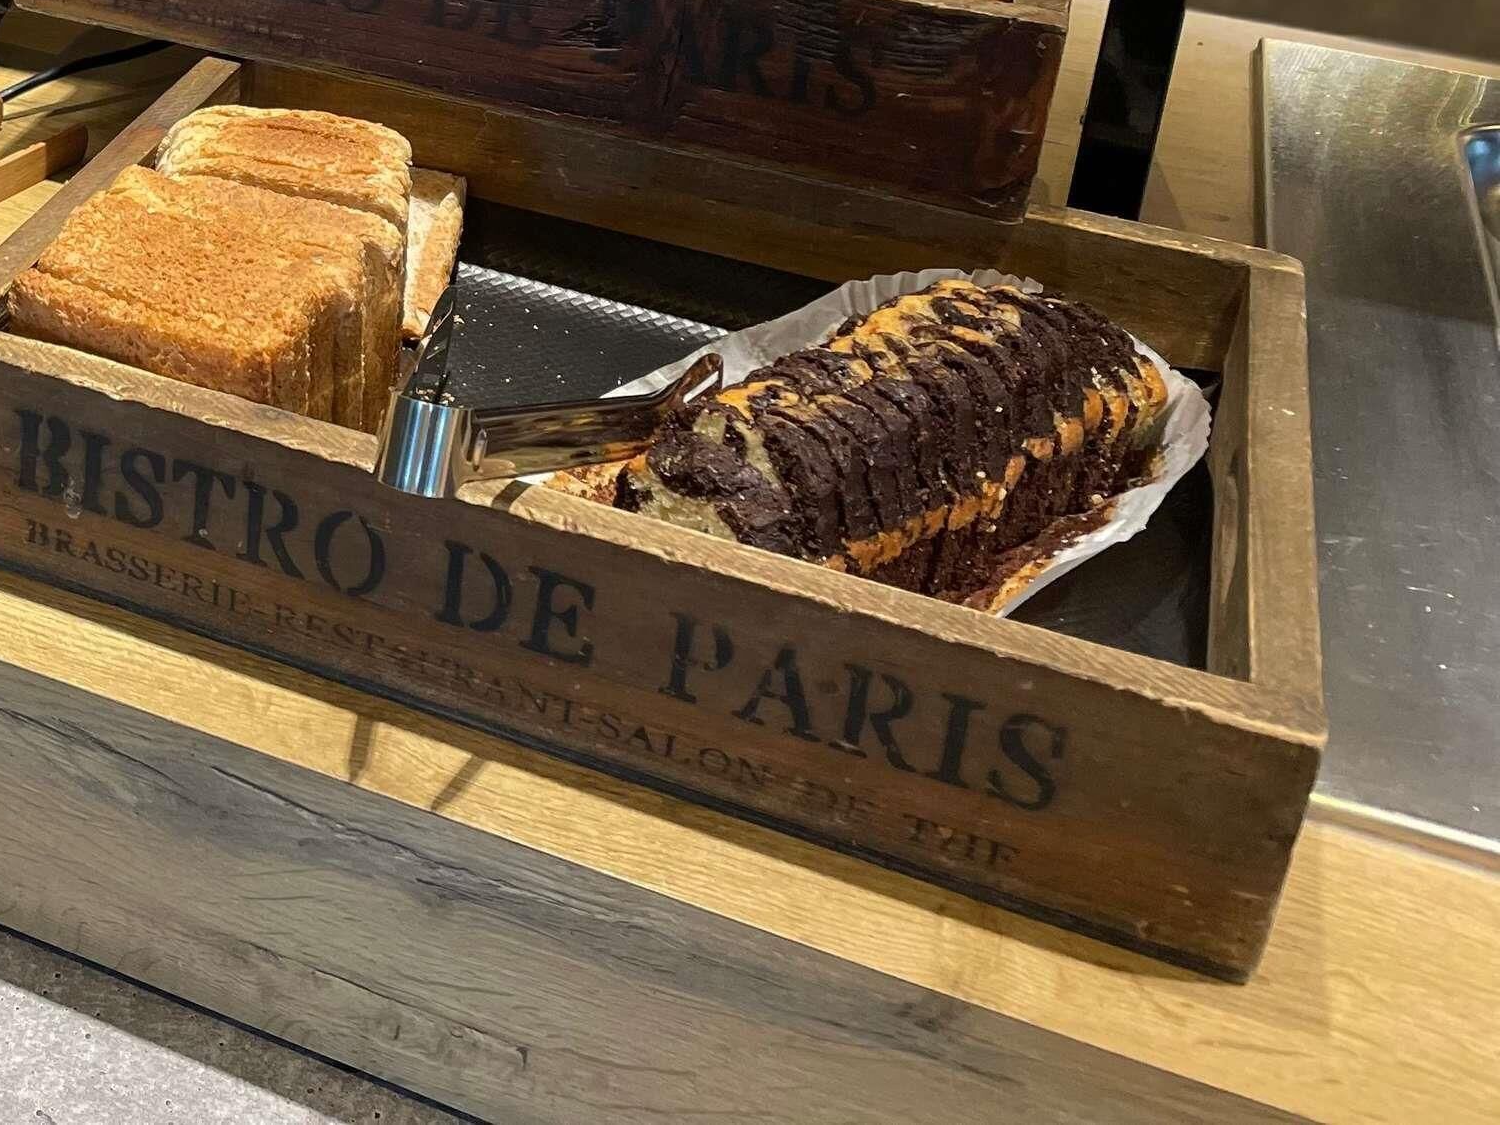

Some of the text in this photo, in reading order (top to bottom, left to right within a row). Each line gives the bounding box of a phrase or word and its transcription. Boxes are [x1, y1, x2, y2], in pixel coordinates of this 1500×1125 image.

[13, 408, 1070, 812] BISTRO DE PARIS
